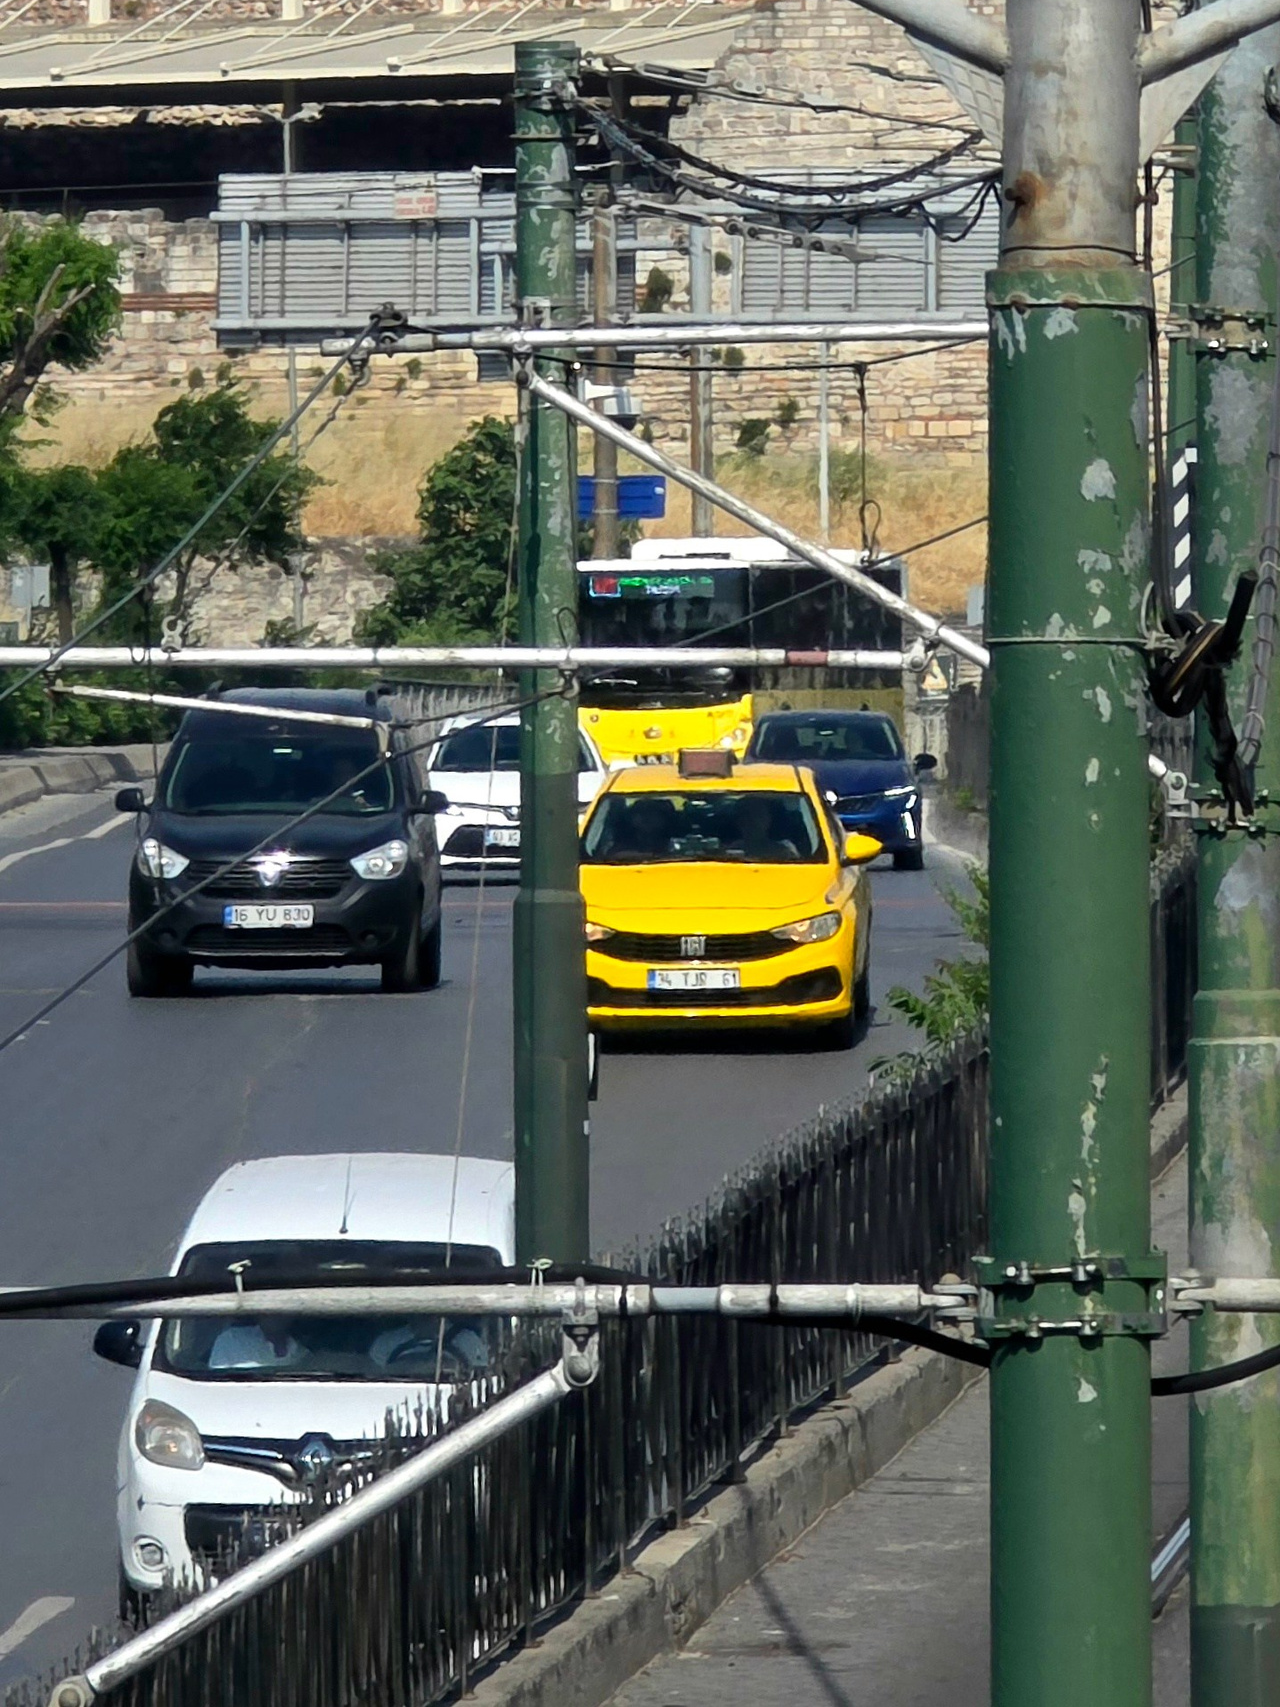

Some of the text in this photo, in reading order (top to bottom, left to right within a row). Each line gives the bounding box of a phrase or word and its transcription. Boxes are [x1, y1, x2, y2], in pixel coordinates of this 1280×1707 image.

[234, 908, 248, 922] 16
[256, 908, 277, 922] YU
[722, 972, 737, 986] 61
